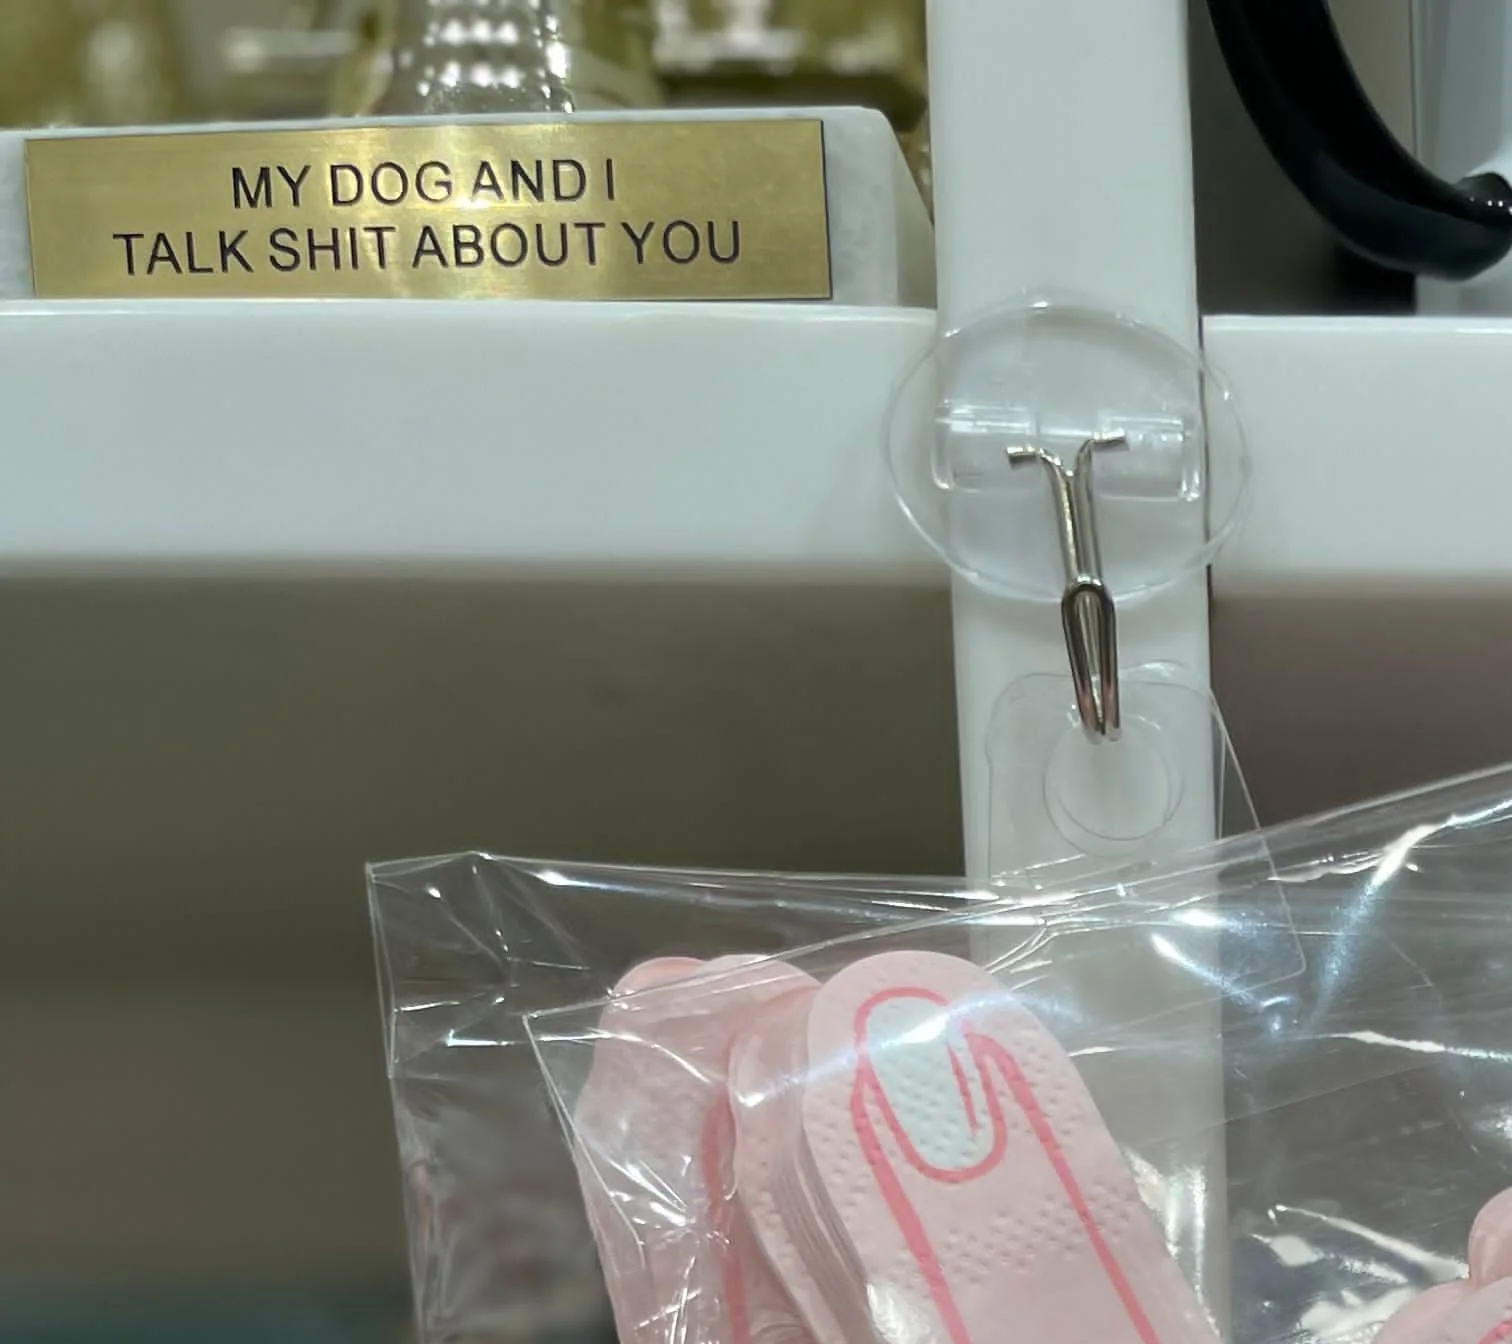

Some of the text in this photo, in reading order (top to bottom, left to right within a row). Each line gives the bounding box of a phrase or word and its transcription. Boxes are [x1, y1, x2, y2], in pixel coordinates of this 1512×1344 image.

[232, 158, 615, 209] MY DOG AND I
[113, 219, 741, 275] TALK SHIT ABOUT YOU
